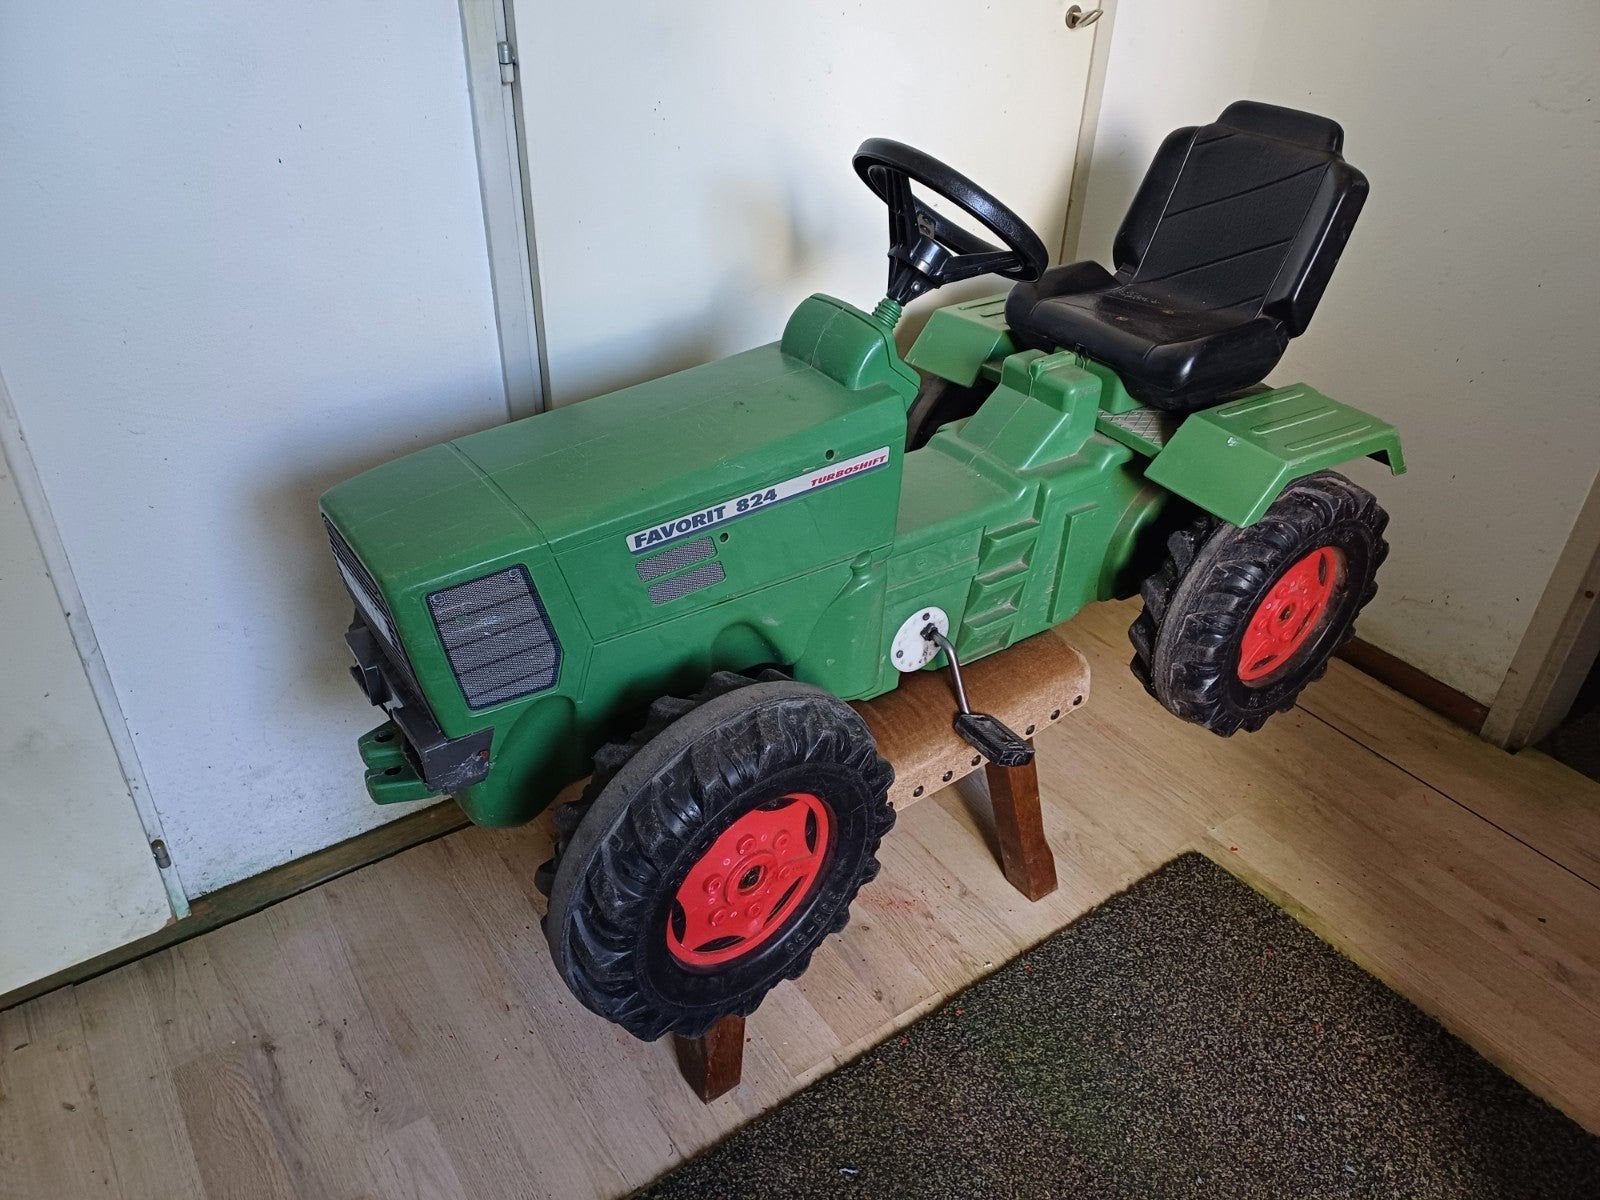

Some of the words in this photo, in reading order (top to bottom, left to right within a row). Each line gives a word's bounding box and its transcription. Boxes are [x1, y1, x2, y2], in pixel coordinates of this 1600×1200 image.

[810, 455, 886, 487] TURBOSHIFT
[634, 506, 726, 549] FAVORIT
[736, 488, 777, 513] 824
